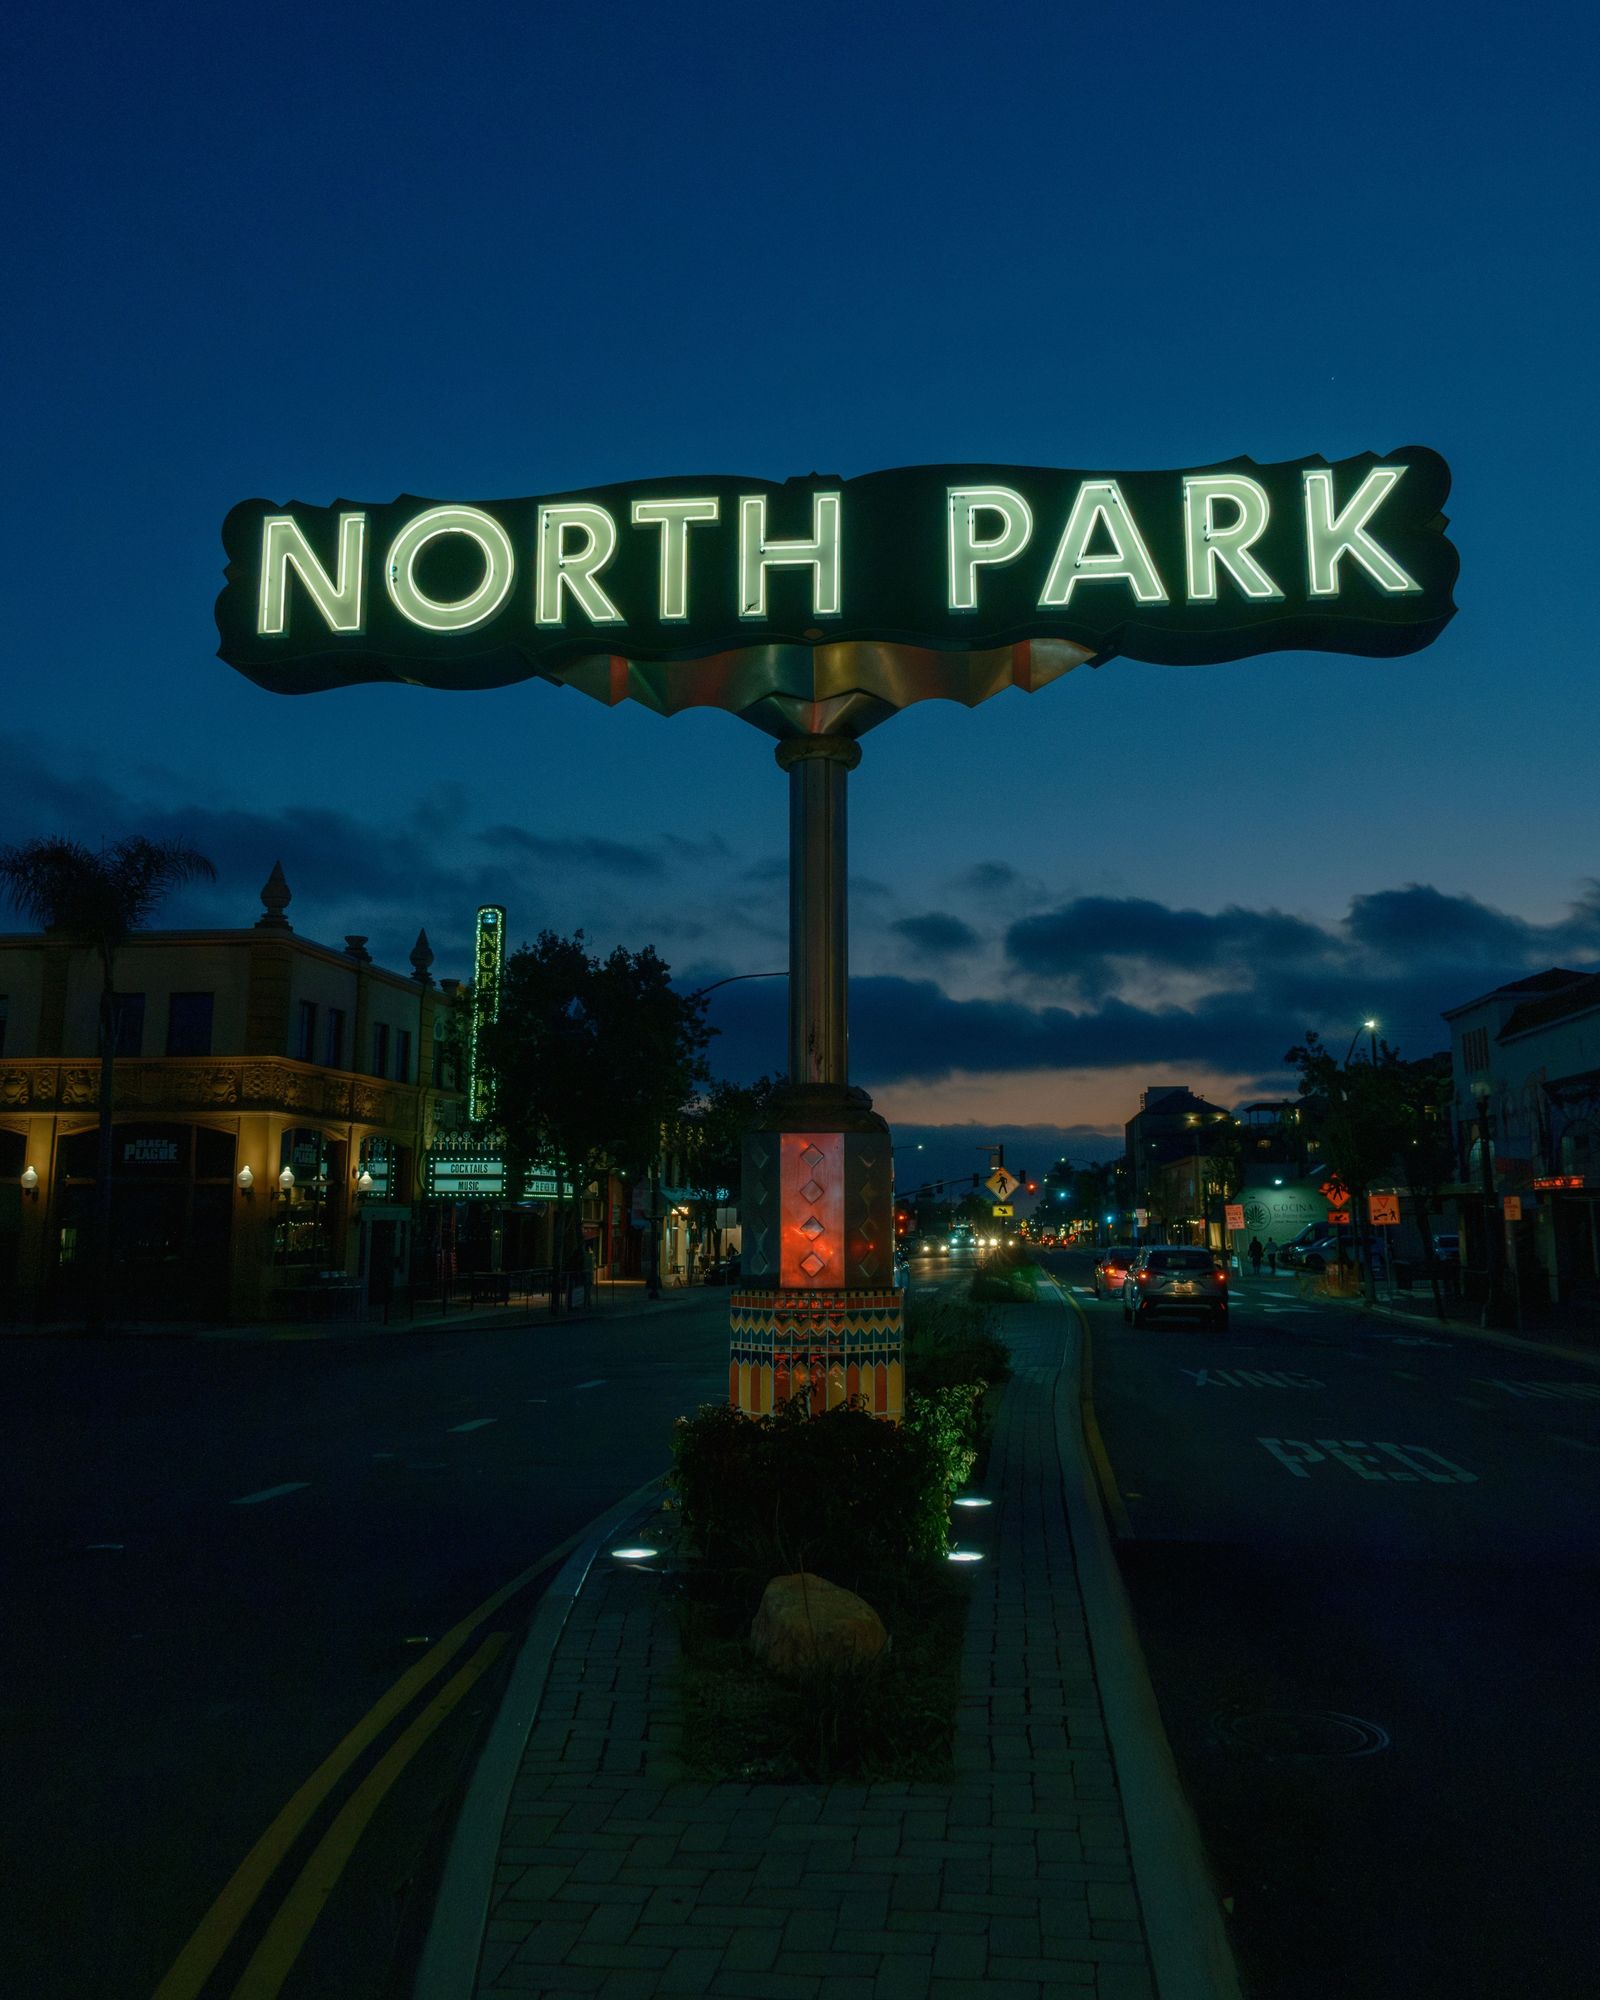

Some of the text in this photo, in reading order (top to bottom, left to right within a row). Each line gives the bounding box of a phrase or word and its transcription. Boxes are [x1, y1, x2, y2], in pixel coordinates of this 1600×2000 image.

[257, 465, 1423, 637] NORTH PARK
[449, 1164, 489, 1174] COCKTAILS
[457, 1181, 480, 1191] MUSIC
[1255, 1436, 1481, 1484] PED
